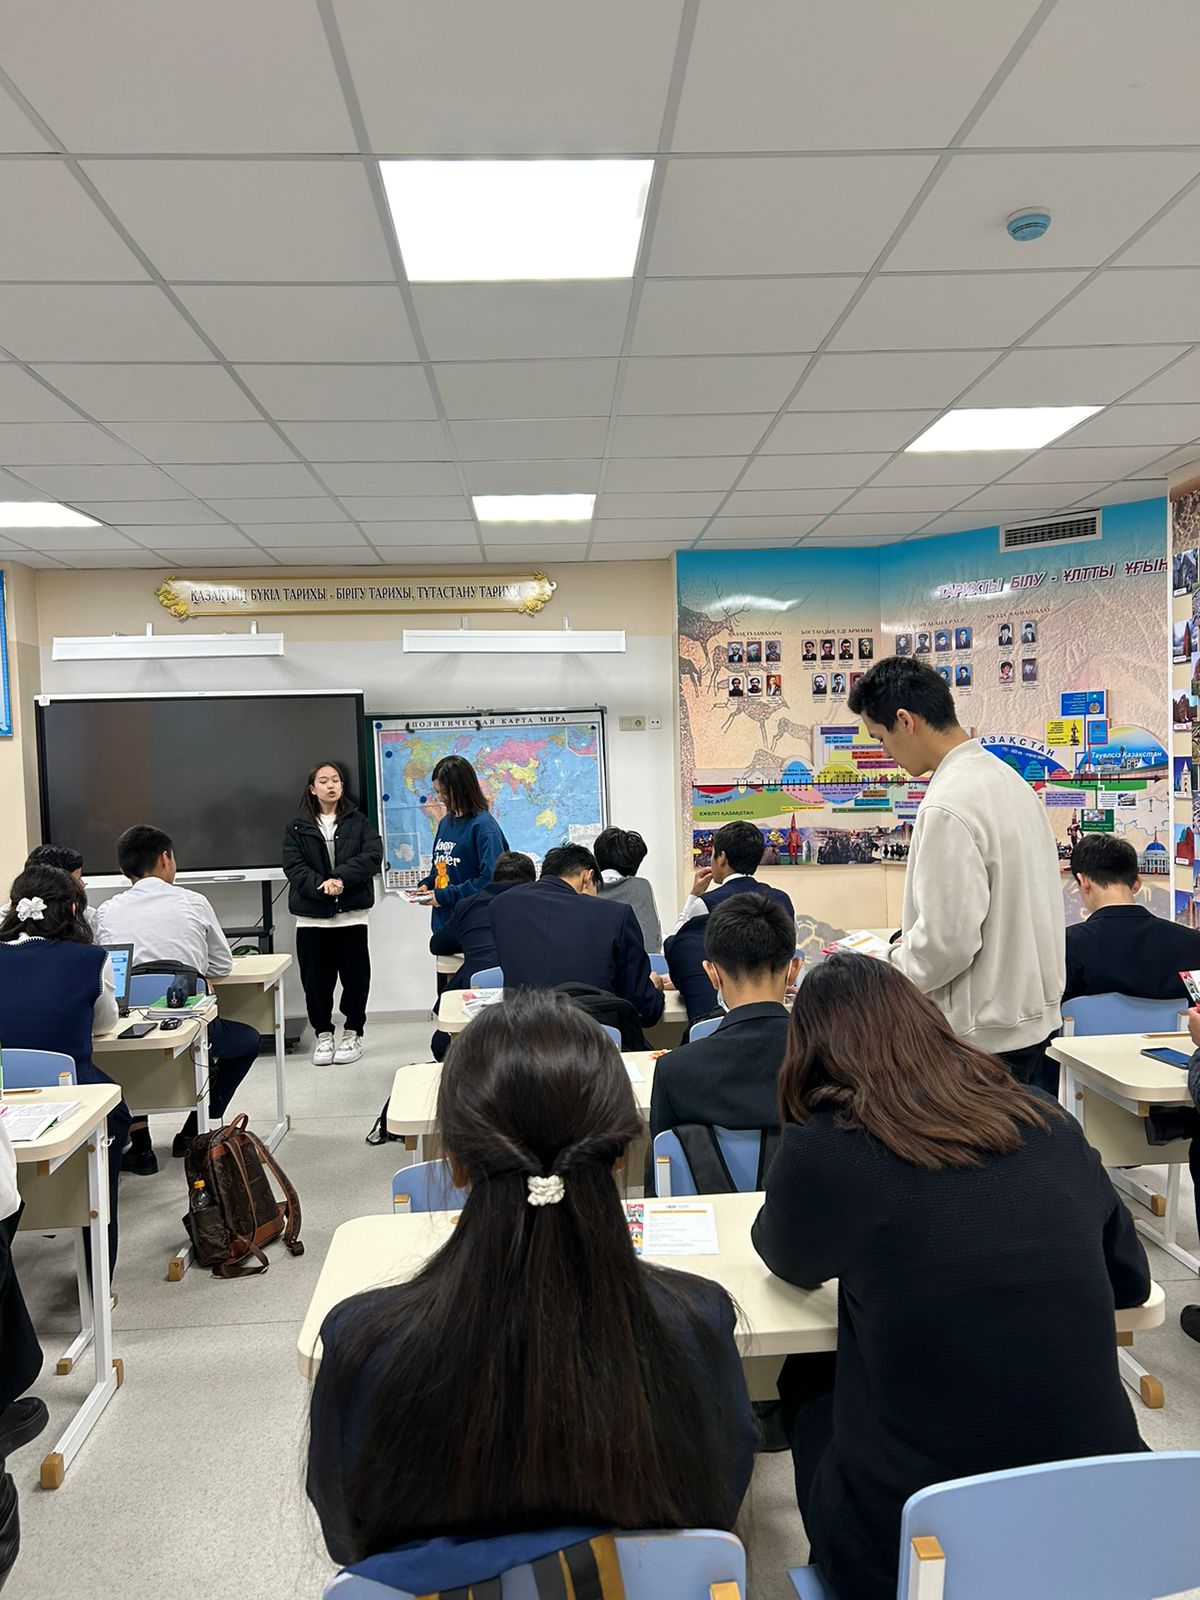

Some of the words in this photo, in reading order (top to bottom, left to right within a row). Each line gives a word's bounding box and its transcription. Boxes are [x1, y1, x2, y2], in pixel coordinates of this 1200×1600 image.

[938, 579, 1003, 598] ТАРИХТЫ
[1010, 572, 1046, 589] БІЛУ
[1062, 563, 1115, 582] ҰЛТТЫ
[190, 588, 248, 605] ҚАЗАҚТЫҢ
[251, 588, 280, 600] БҮКІЛ
[282, 588, 326, 600] ТАРИХЫ
[336, 587, 366, 600] БІРІГУ
[369, 586, 415, 601] ТАРИХЫ,
[417, 585, 477, 599] ТҰТАСТАНУ
[412, 718, 495, 728] ПОЛИТИЧЕСАЯ
[501, 717, 533, 725] КАРТА
[980, 735, 1055, 758] АЗАҚСТАН
